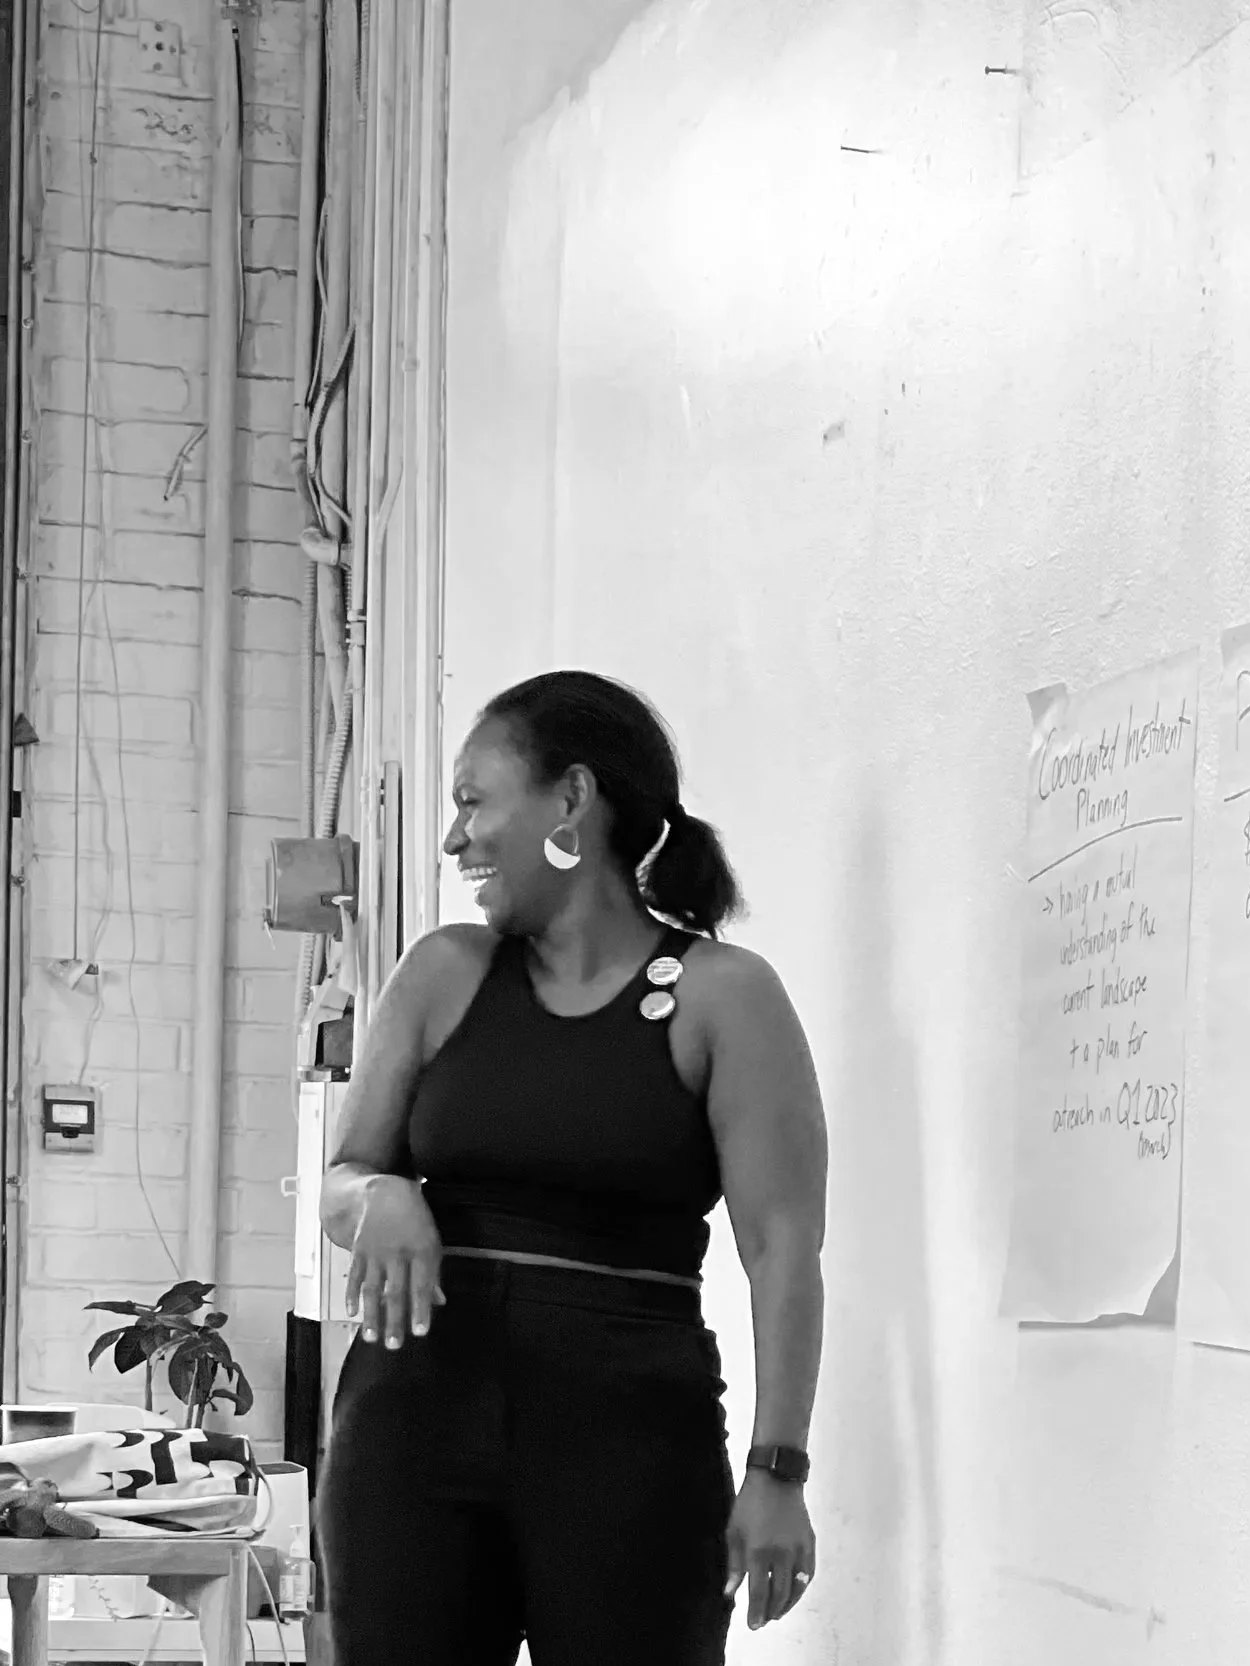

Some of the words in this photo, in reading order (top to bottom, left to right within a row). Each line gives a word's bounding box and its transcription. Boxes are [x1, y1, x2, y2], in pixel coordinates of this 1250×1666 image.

[1039, 723, 1120, 800] Coordinated
[1125, 697, 1190, 767] Investment
[1077, 788, 1128, 831] Planning
[1121, 901, 1134, 943] of
[1140, 904, 1155, 940] the
[1096, 1023, 1119, 1074] plan
[1127, 1021, 1148, 1059] for
[1100, 1106, 1111, 1124] in
[1117, 1078, 1140, 1130] Q1
